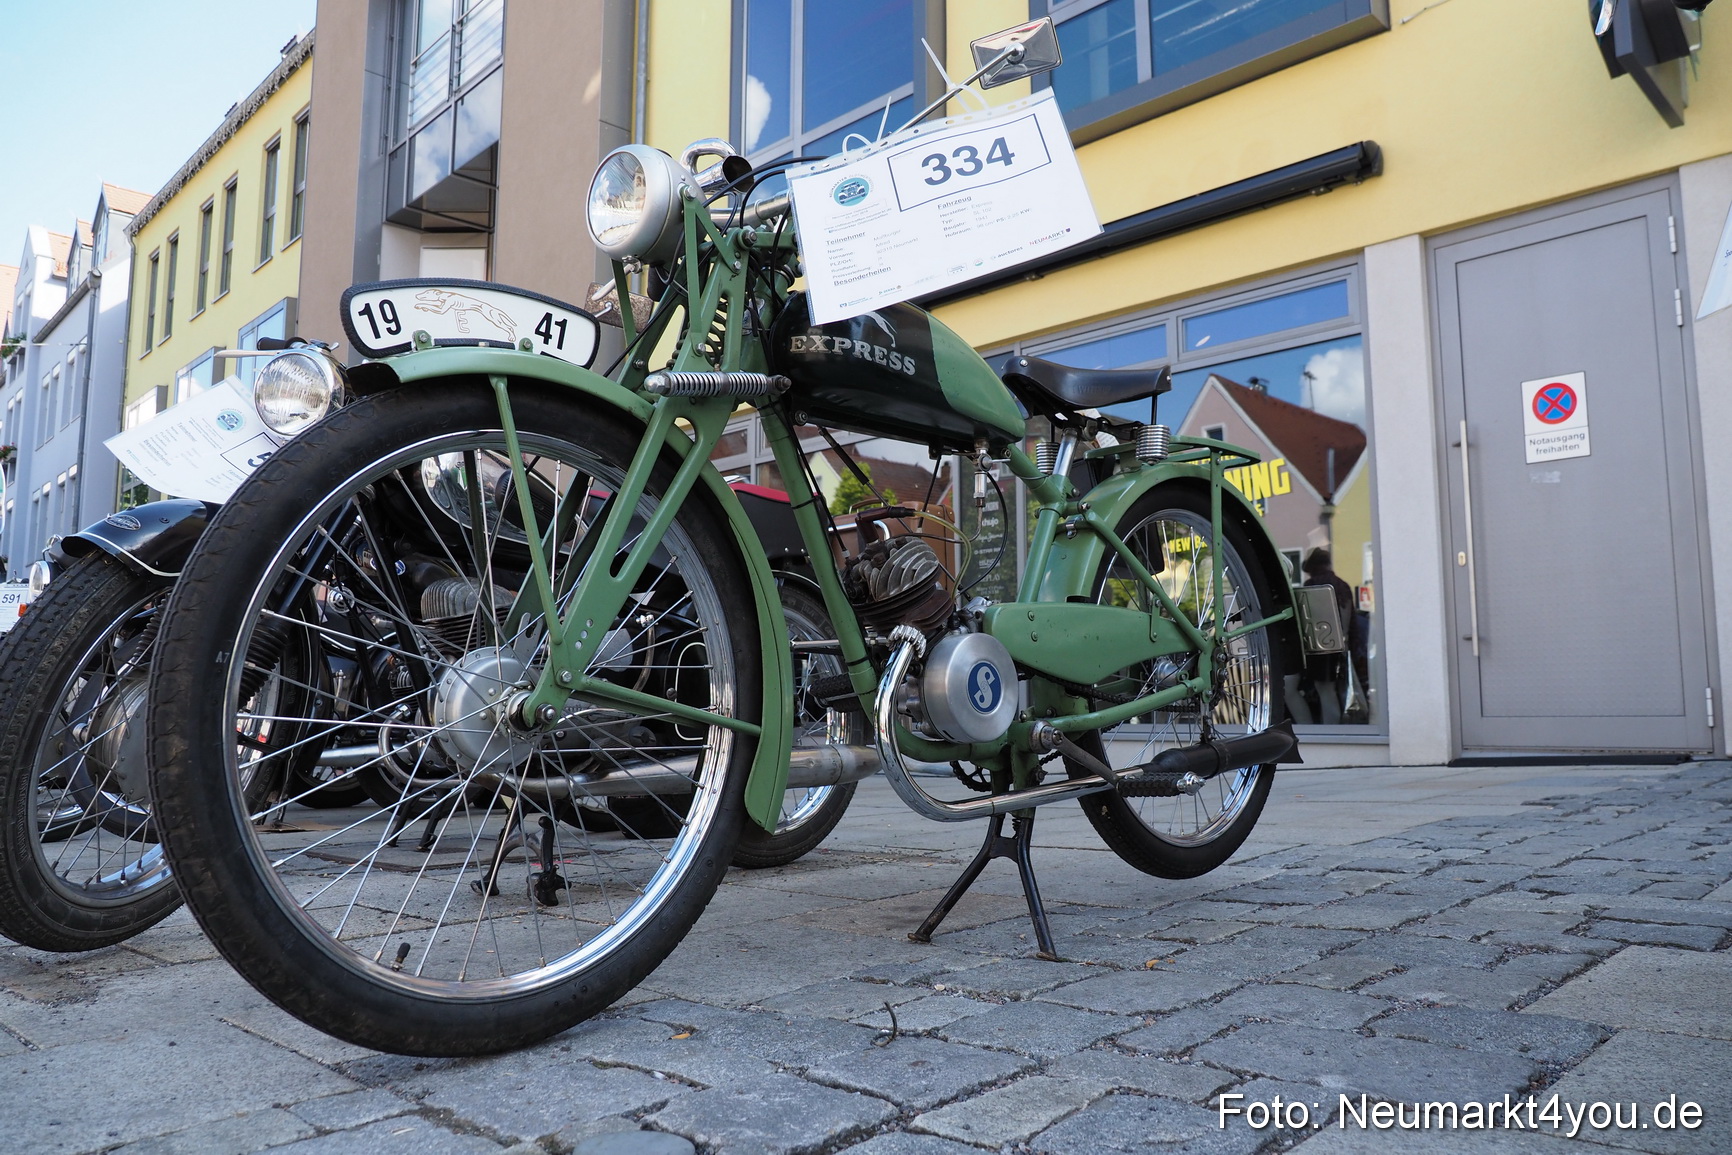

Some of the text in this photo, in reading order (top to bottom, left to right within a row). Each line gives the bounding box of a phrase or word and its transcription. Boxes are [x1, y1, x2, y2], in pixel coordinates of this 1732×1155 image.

[921, 137, 1015, 186] 334
[937, 196, 972, 210] Fahrzeug
[826, 231, 866, 246] Teilnehmer
[1028, 229, 1065, 246] NEUMARKT
[833, 266, 892, 287] Besonderheiten
[357, 299, 569, 350] 19 41
[790, 335, 916, 376] EXPRESS
[1529, 432, 1586, 447] Notausgang
[1535, 443, 1580, 455] freihalten
[1169, 536, 1191, 553] NEW
[1, 593, 21, 604] 591
